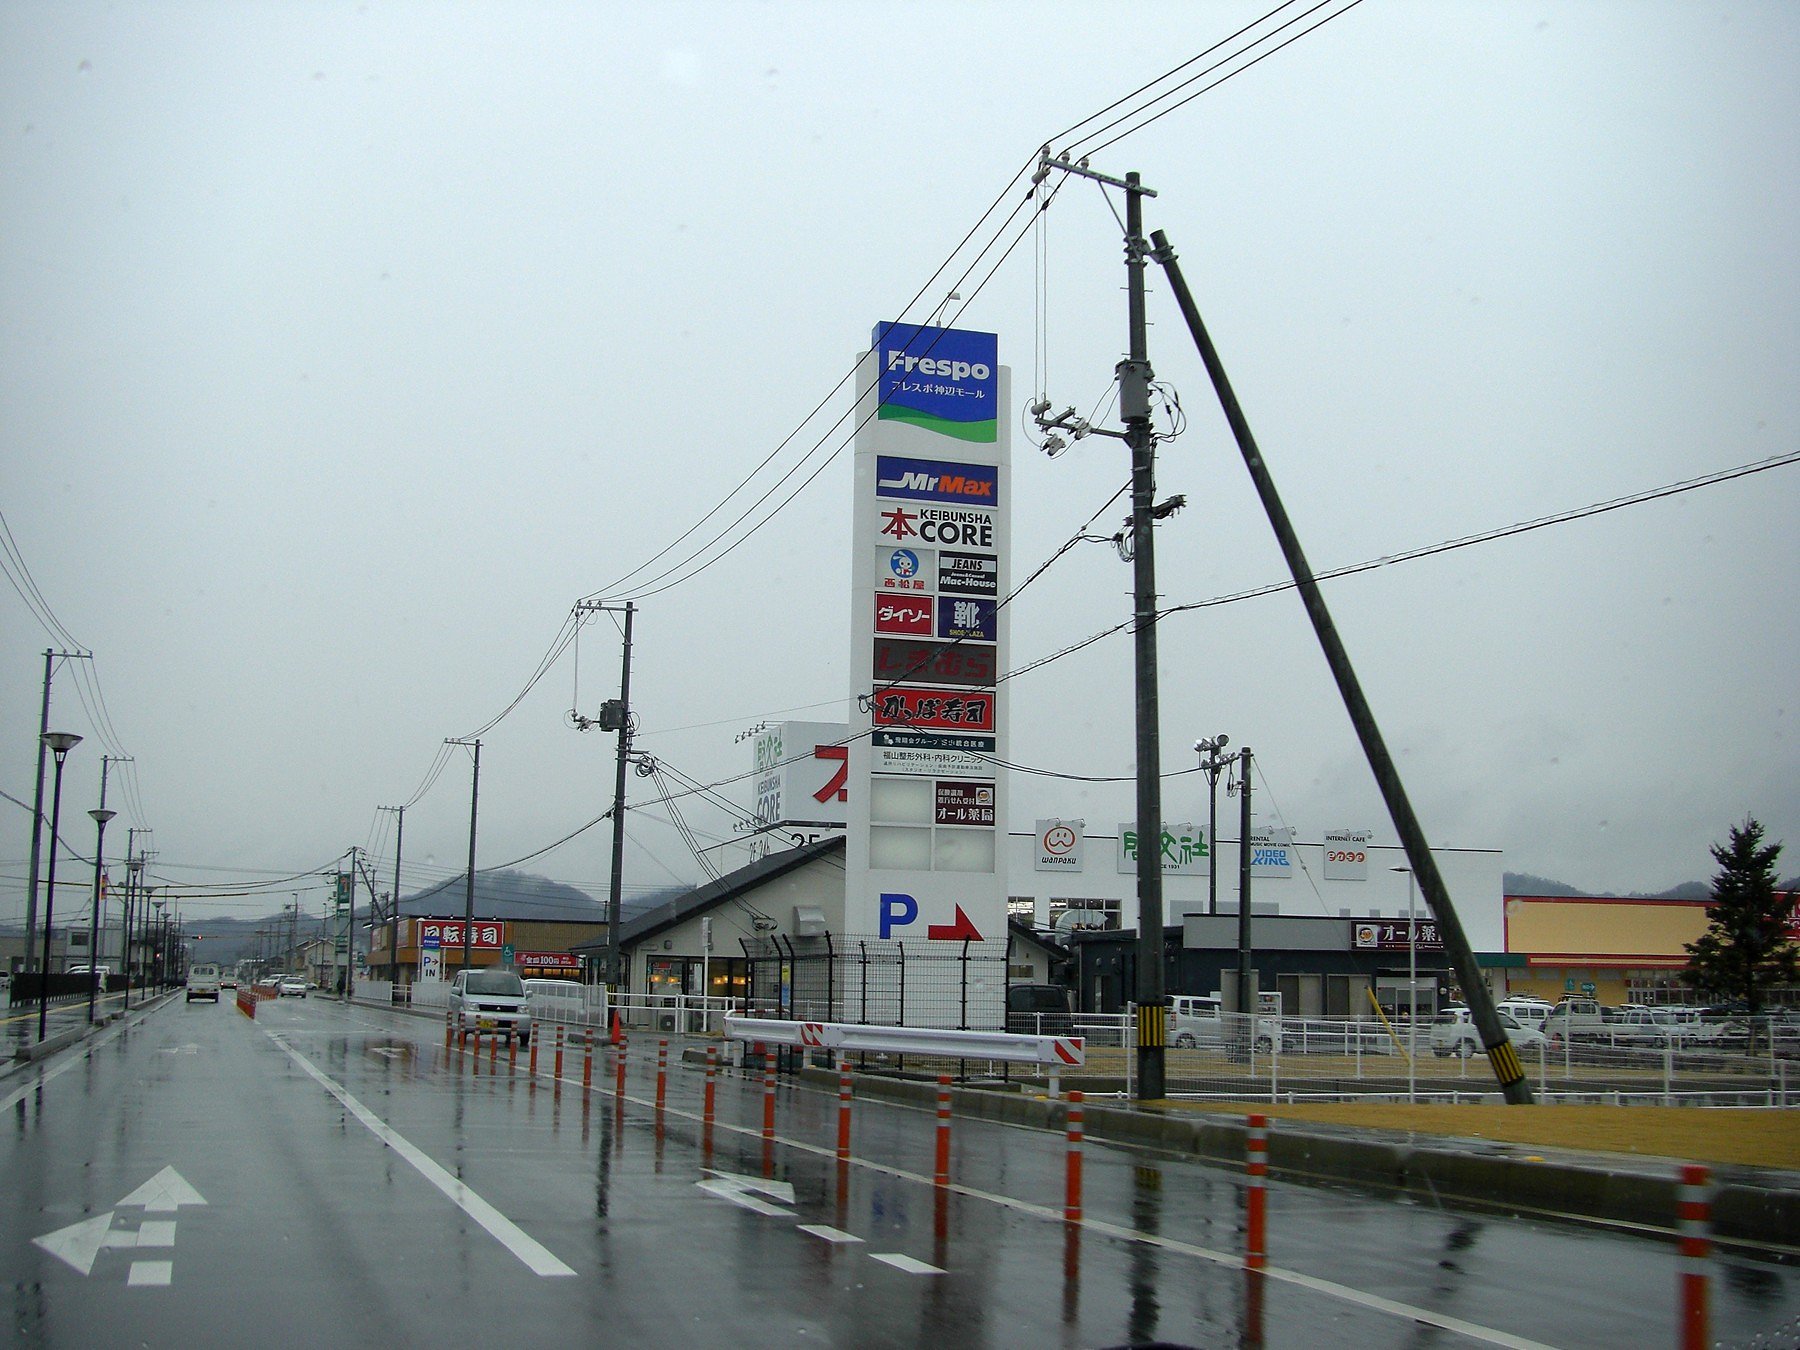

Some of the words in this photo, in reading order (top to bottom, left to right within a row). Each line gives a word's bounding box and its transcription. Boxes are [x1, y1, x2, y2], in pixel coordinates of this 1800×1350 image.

[888, 350, 990, 381] Frespo
[878, 471, 992, 496] MrMax
[881, 508, 918, 540] 本
[920, 509, 992, 525] KEIBUNSHA
[919, 520, 993, 547] CORE
[951, 559, 983, 571] JEANS
[884, 577, 925, 590] 西松屋
[940, 576, 996, 588] Mac-House
[878, 606, 930, 623] ダイソー
[954, 601, 980, 628] 靴
[937, 807, 994, 822] オール薬局
[1254, 849, 1286, 857] VIDEO
[1251, 857, 1290, 866] KING
[879, 893, 918, 939] P
[423, 956, 432, 967] P
[425, 969, 436, 977] IN
